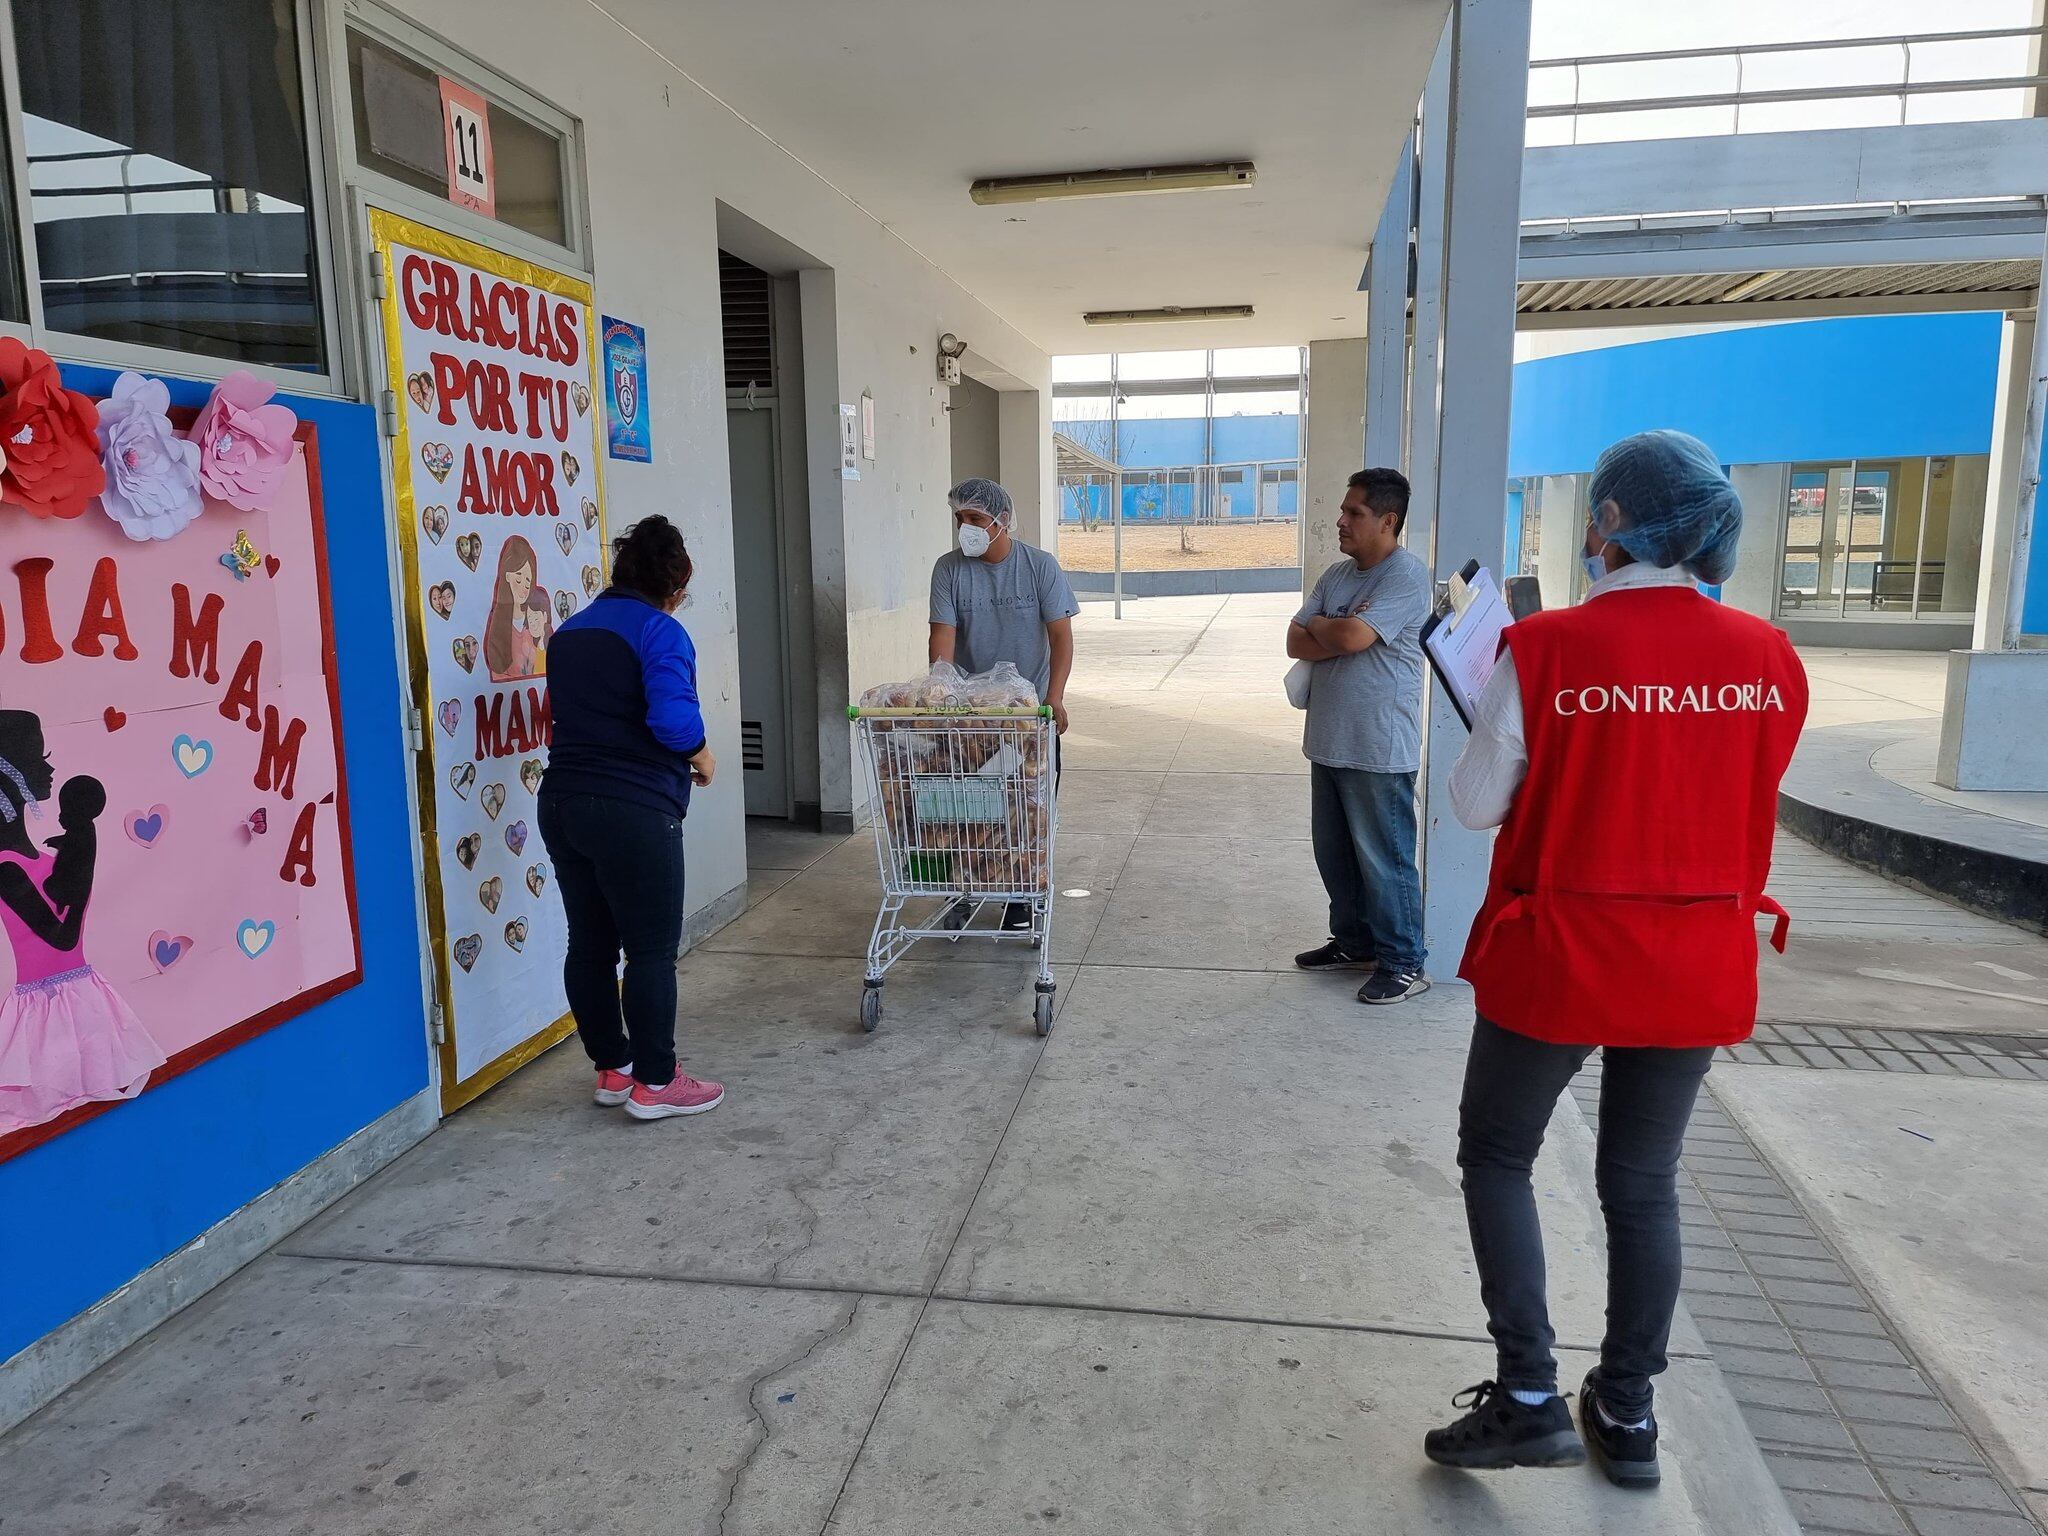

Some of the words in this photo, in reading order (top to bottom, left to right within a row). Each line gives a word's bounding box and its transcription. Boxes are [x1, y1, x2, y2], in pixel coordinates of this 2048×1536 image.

[456, 114, 484, 184] 11
[402, 254, 578, 367] GRACIAS
[430, 351, 518, 435] POR
[519, 372, 568, 442] TU
[457, 443, 560, 516] AMOR
[0, 557, 139, 664] IA
[168, 582, 334, 887] MAMÁ
[474, 686, 553, 762] MAM
[1554, 678, 1785, 716] CONTRALORÍA
